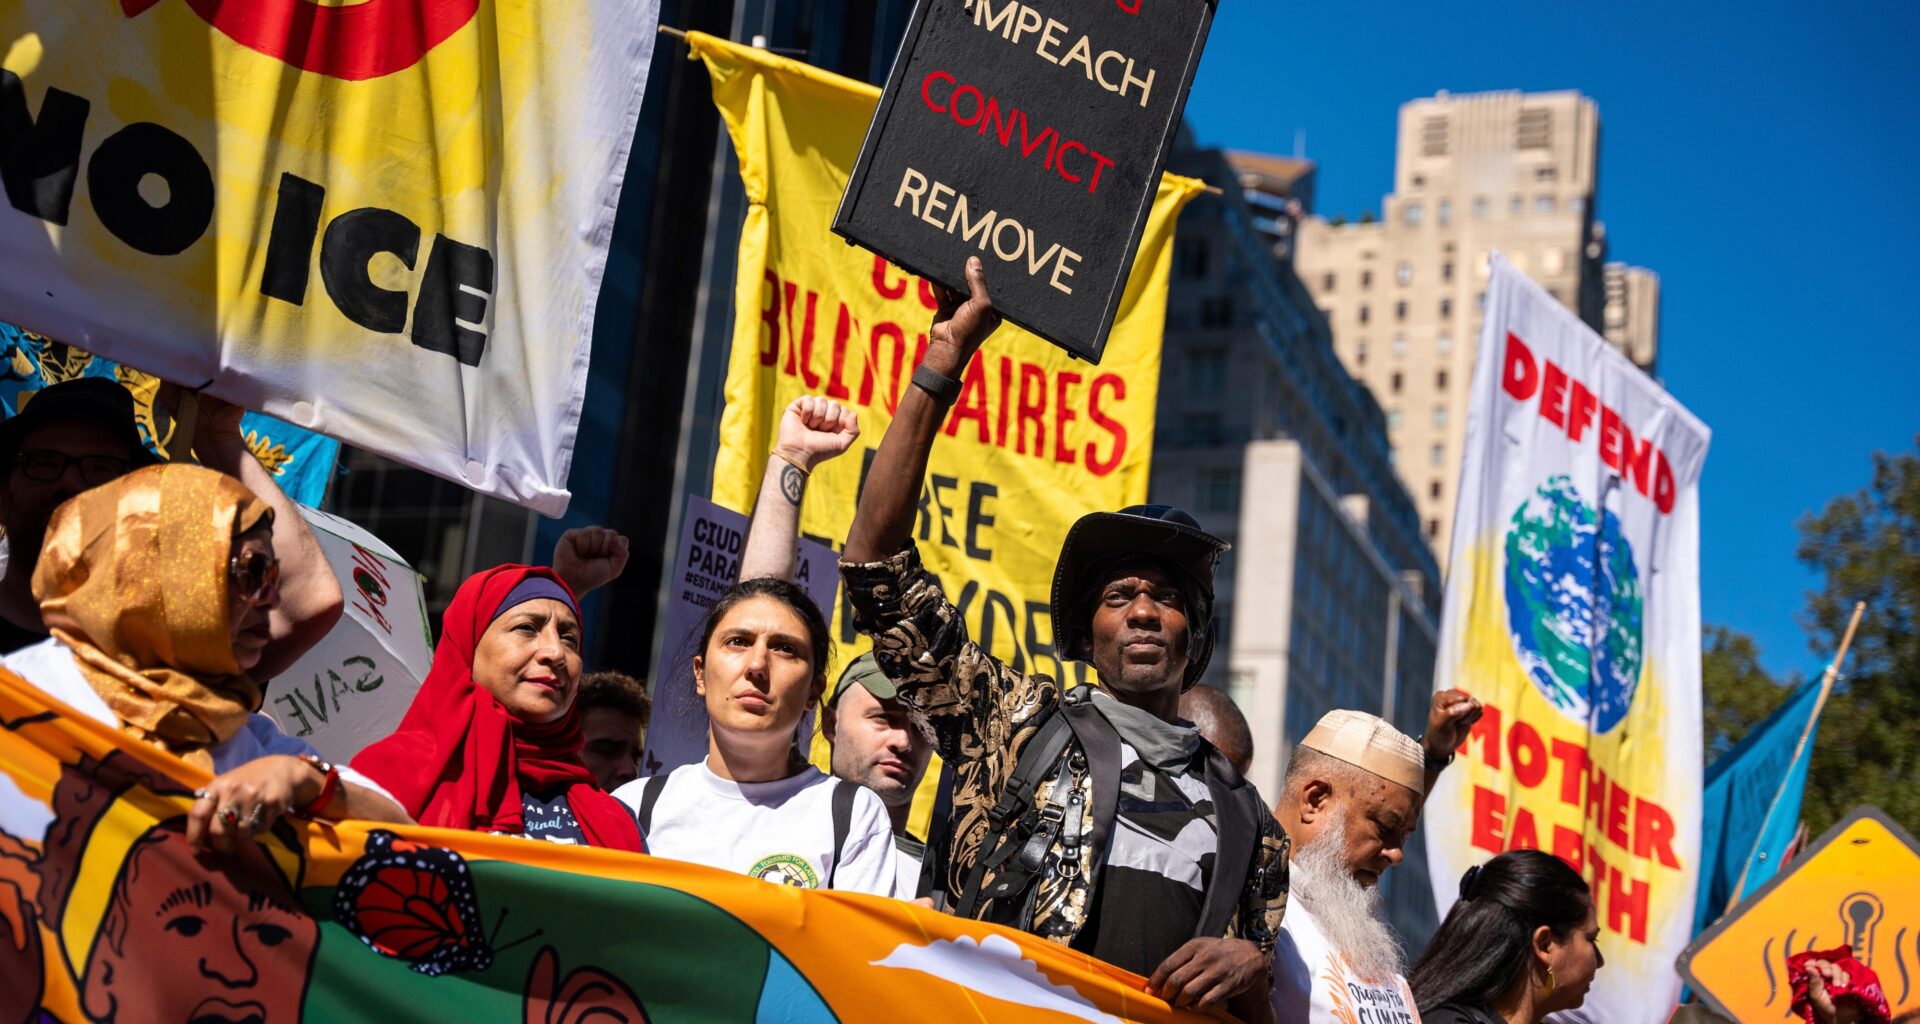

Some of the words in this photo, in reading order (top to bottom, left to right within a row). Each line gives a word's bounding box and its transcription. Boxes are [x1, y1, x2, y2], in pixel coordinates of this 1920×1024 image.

[964, 0, 1156, 107] MPEACH
[921, 71, 1115, 194] CONVICT
[0, 67, 215, 256] NO
[260, 172, 494, 367] ICE
[894, 167, 1083, 295] REMOVE
[760, 268, 1128, 477] BILLIOAIRES
[1502, 331, 1676, 515] DEFEND
[693, 517, 741, 555] CIUD
[1453, 688, 1682, 870] MOTHER
